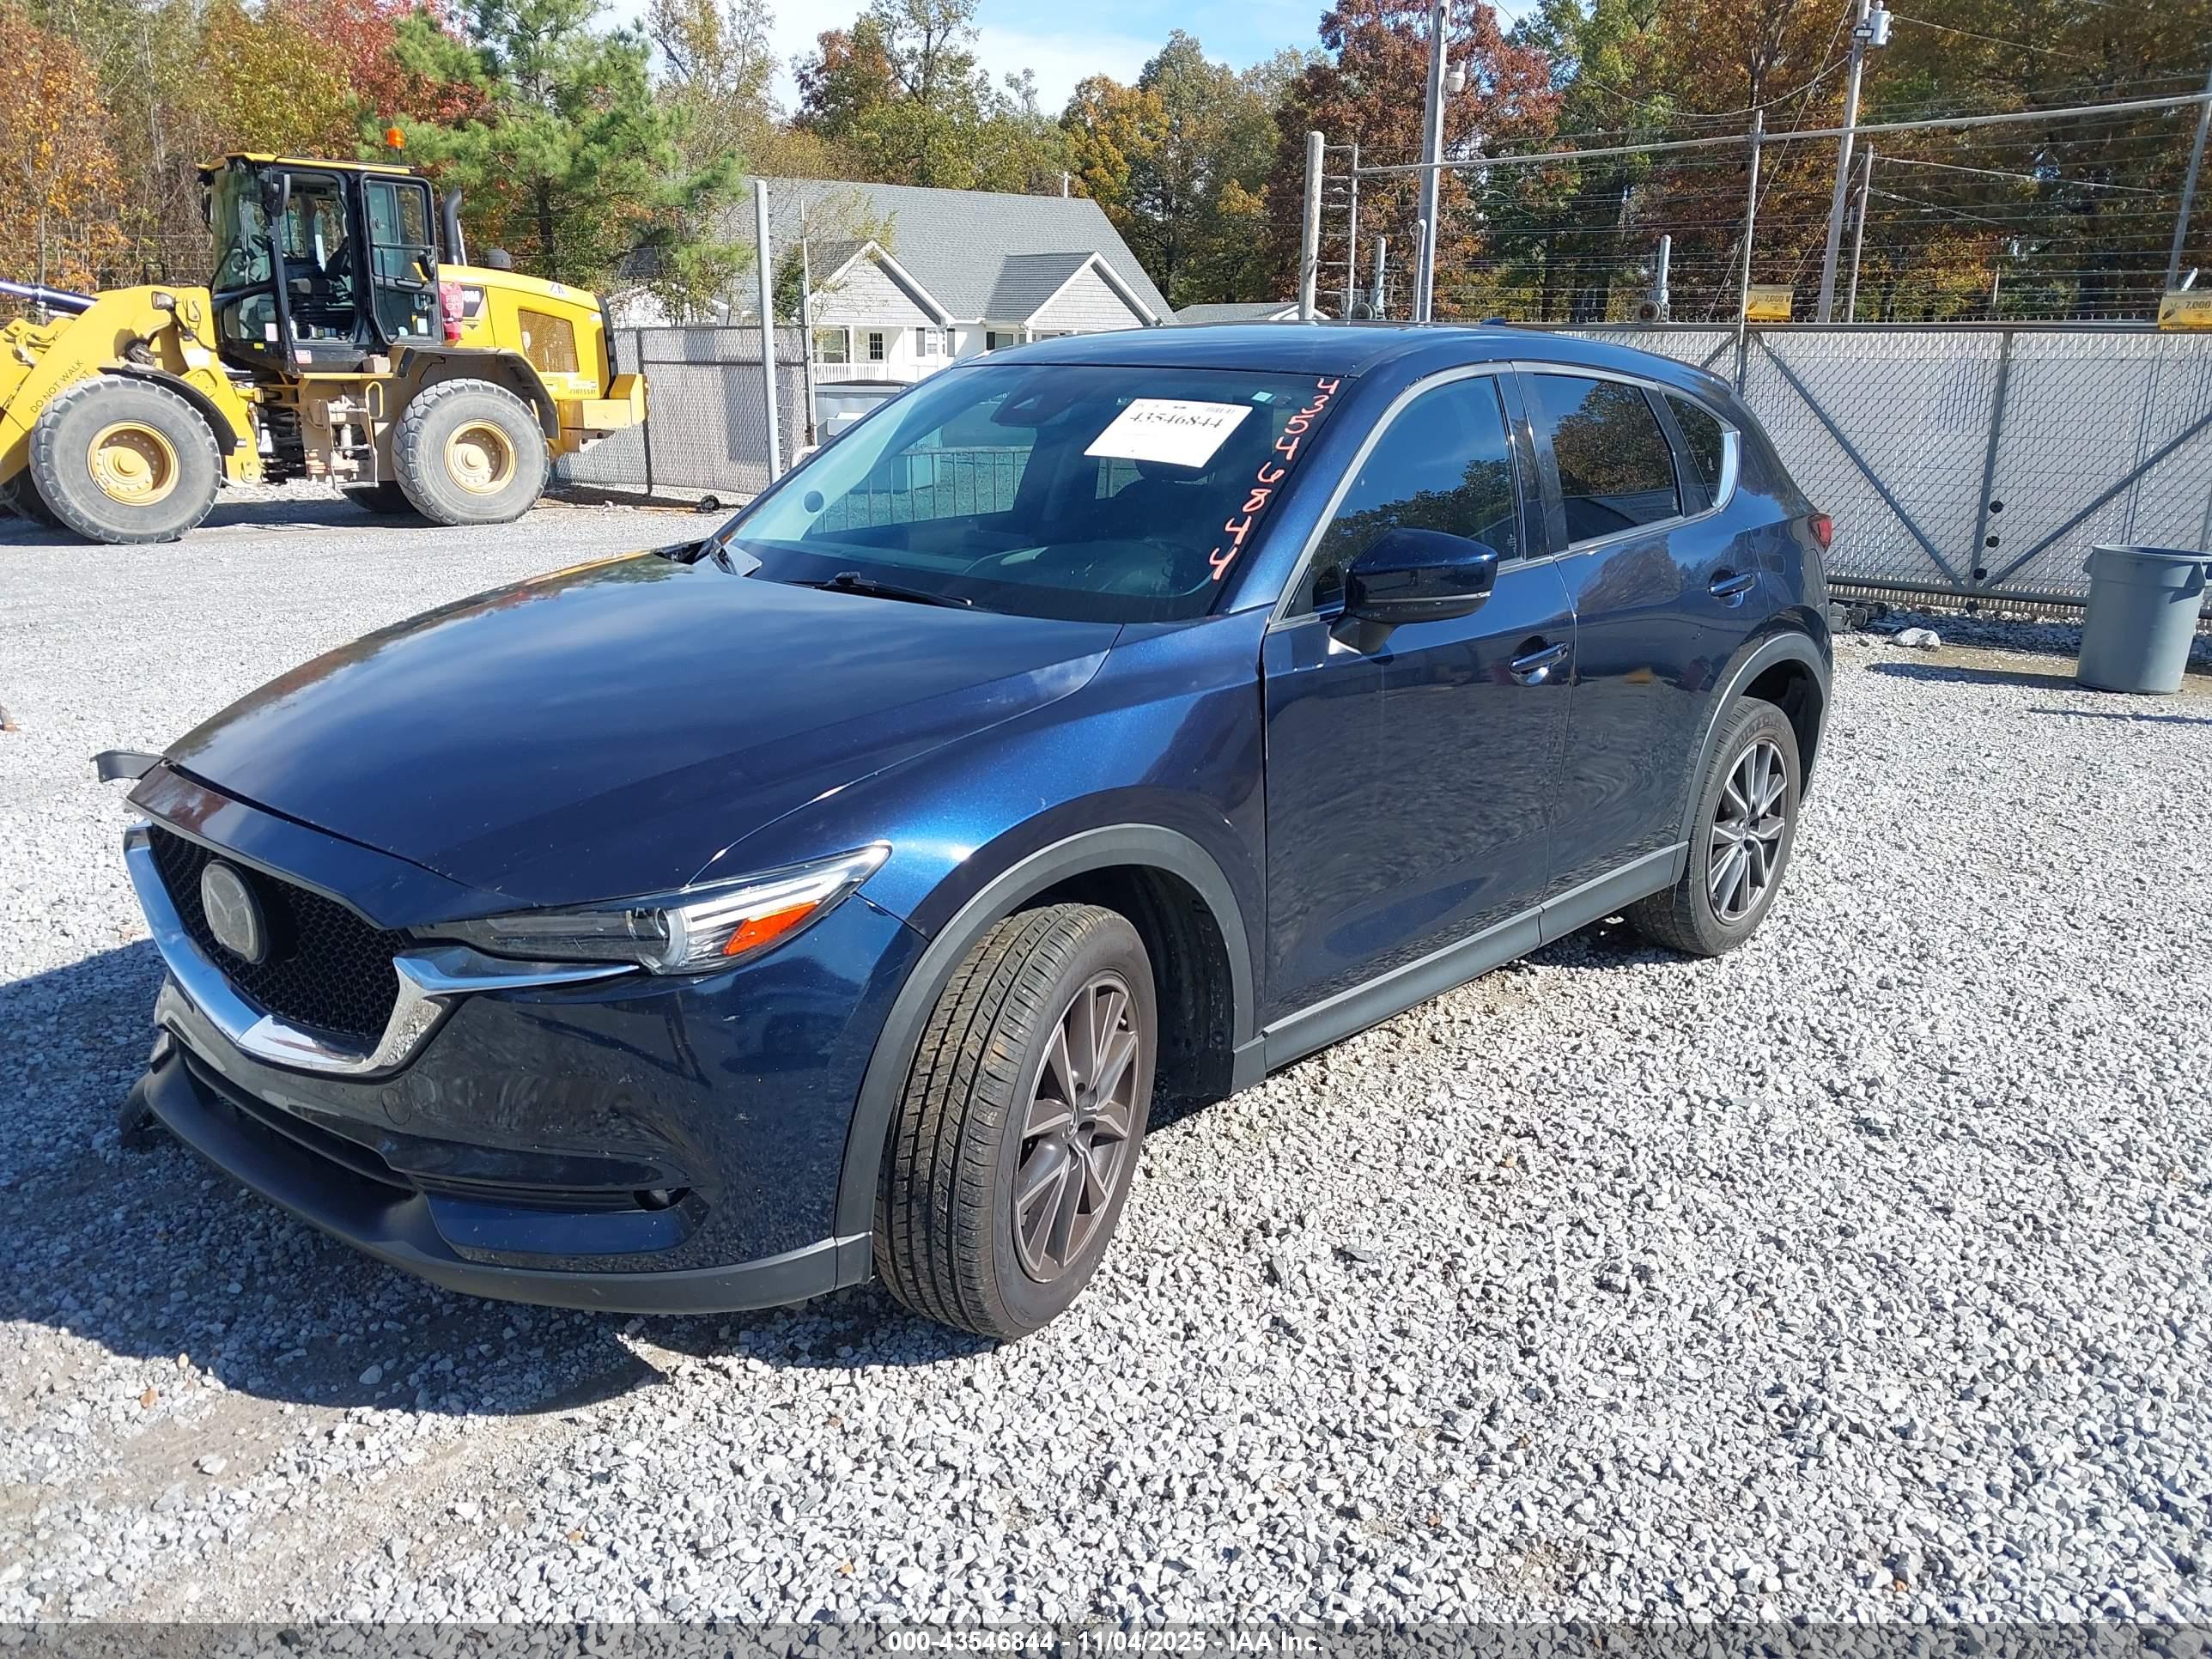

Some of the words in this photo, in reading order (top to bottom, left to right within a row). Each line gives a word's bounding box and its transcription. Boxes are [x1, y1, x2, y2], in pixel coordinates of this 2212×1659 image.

[2185, 301, 2211, 310] 7,000
[29, 399, 44, 413] DO
[43, 381, 61, 400] NOT
[59, 359, 83, 382] WALK
[1129, 411, 1224, 428] 43546844
